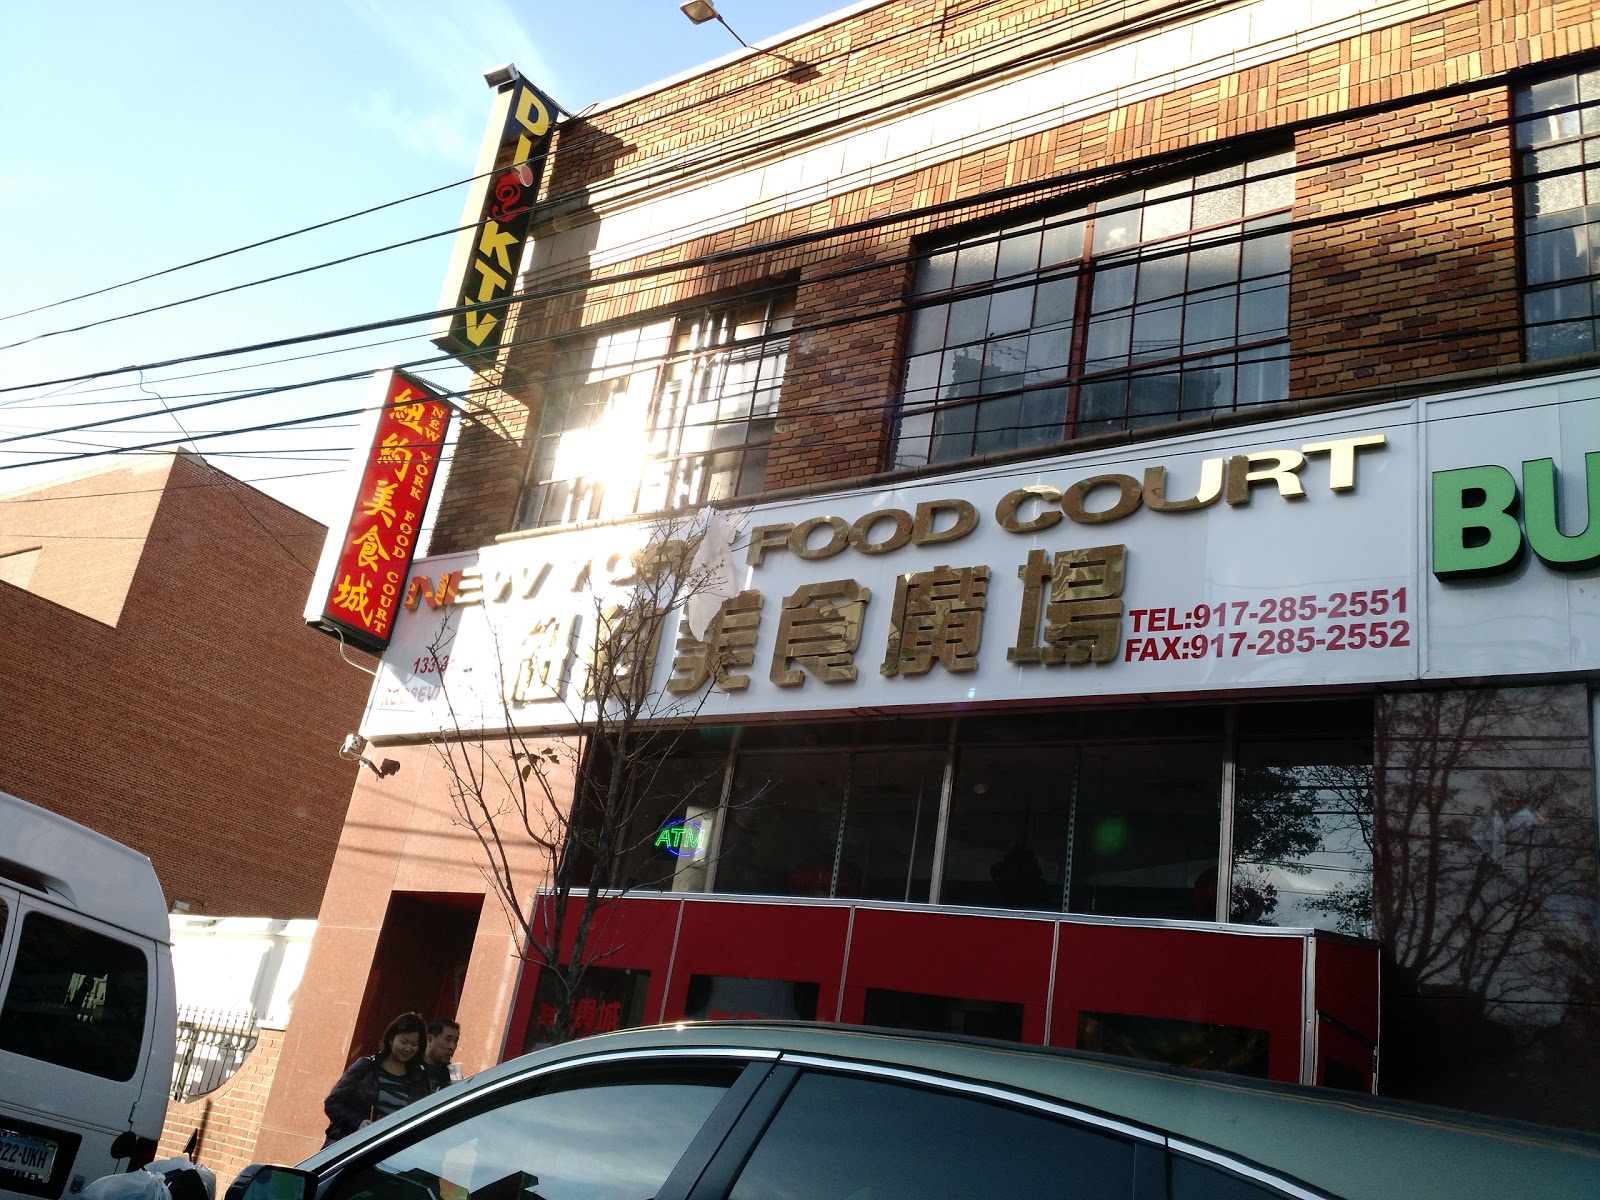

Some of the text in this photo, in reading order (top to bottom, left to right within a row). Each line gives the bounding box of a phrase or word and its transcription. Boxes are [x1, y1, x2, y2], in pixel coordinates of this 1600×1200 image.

[464, 216, 519, 347] KTV
[333, 388, 426, 628] 紐約美食城
[374, 405, 445, 633] NEW YORK FOOD COURT
[746, 499, 980, 566] FOOD
[995, 434, 1387, 534] COURT
[1124, 619, 1411, 663] FAX:917-285-2552
[1129, 586, 1408, 633] TEL:917-285-2551
[655, 827, 706, 849] ATM
